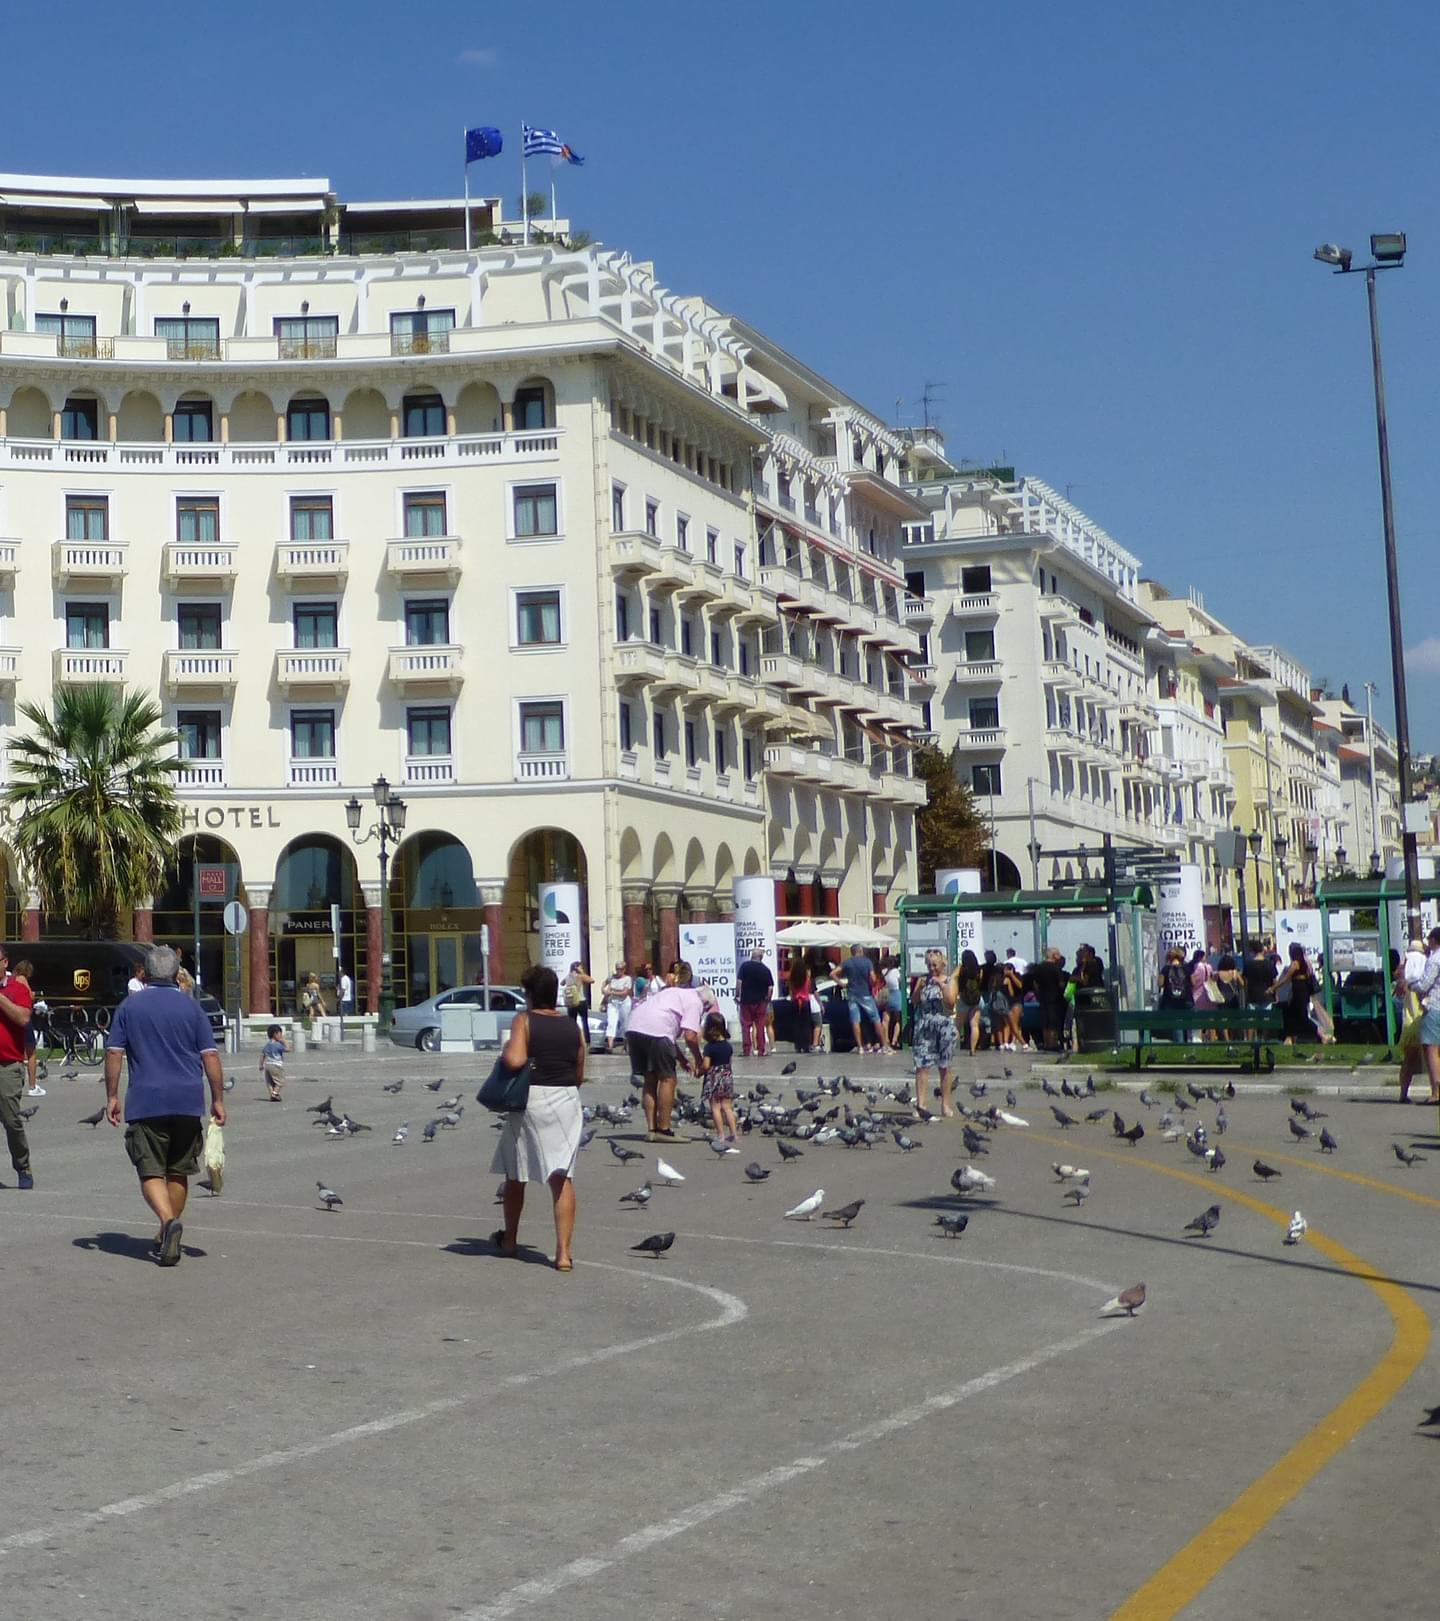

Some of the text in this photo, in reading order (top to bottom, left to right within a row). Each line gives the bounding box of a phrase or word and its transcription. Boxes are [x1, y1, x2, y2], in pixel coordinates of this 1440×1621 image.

[181, 806, 281, 828] HOTEL
[544, 939, 571, 948] FREE
[735, 938, 766, 948] ΩΡΙΣ
[698, 957, 716, 965] ASK
[75, 975, 89, 988] ups
